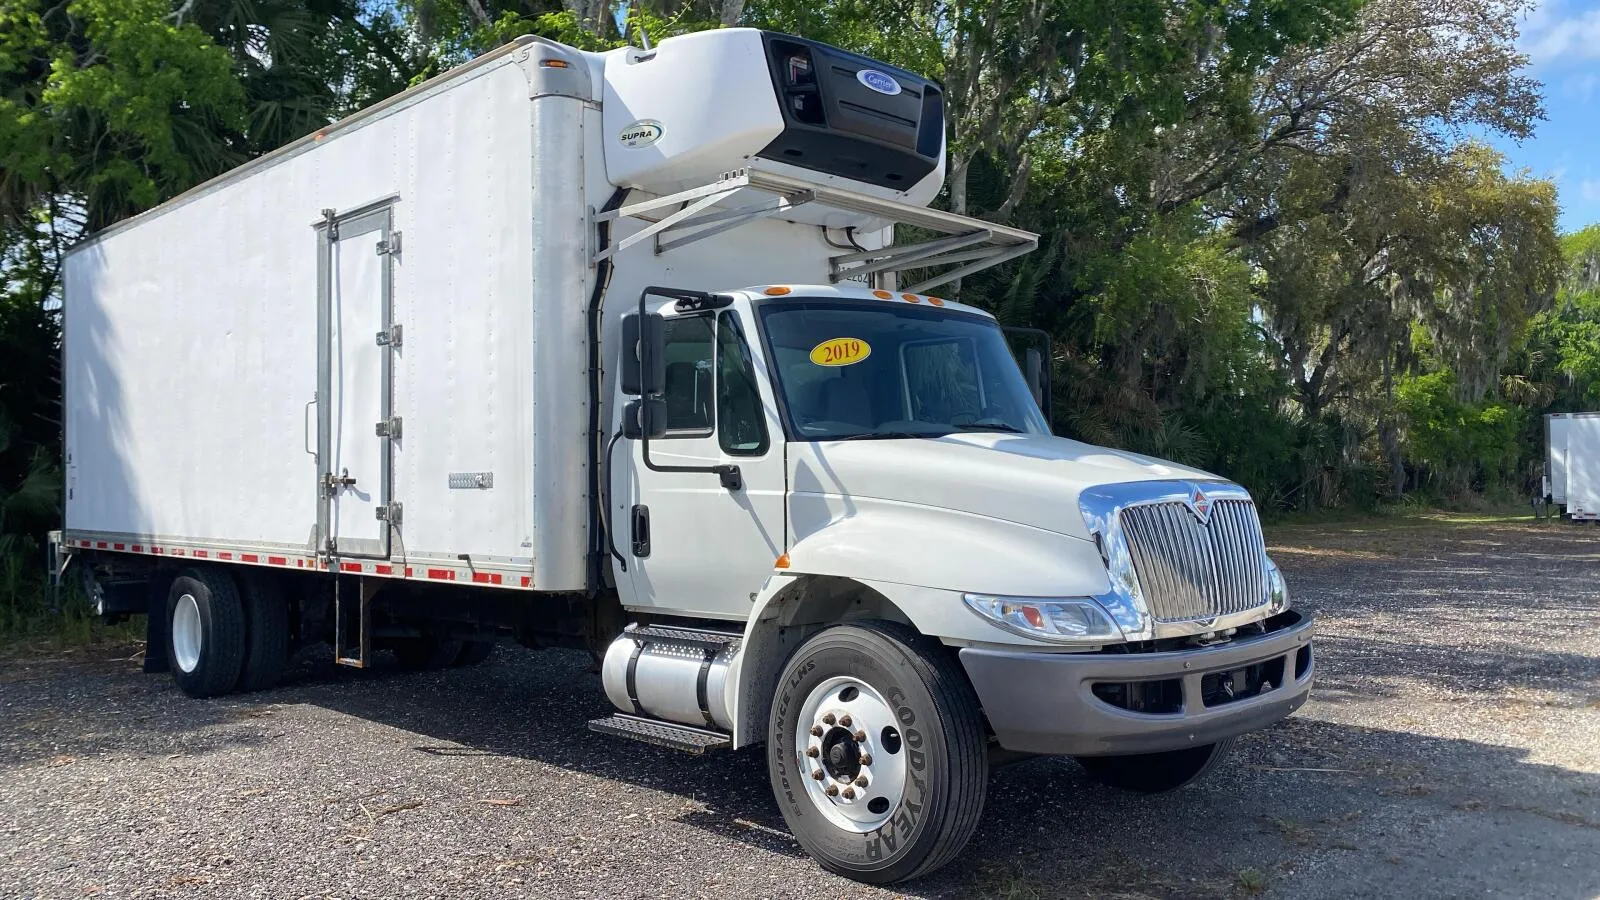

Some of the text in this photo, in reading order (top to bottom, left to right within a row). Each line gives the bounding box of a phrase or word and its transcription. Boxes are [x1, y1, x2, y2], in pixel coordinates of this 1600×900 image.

[621, 130, 652, 141] SUPRA
[823, 341, 860, 363] 2019
[790, 659, 817, 689] LHS
[864, 685, 926, 860] GOODYEAR
